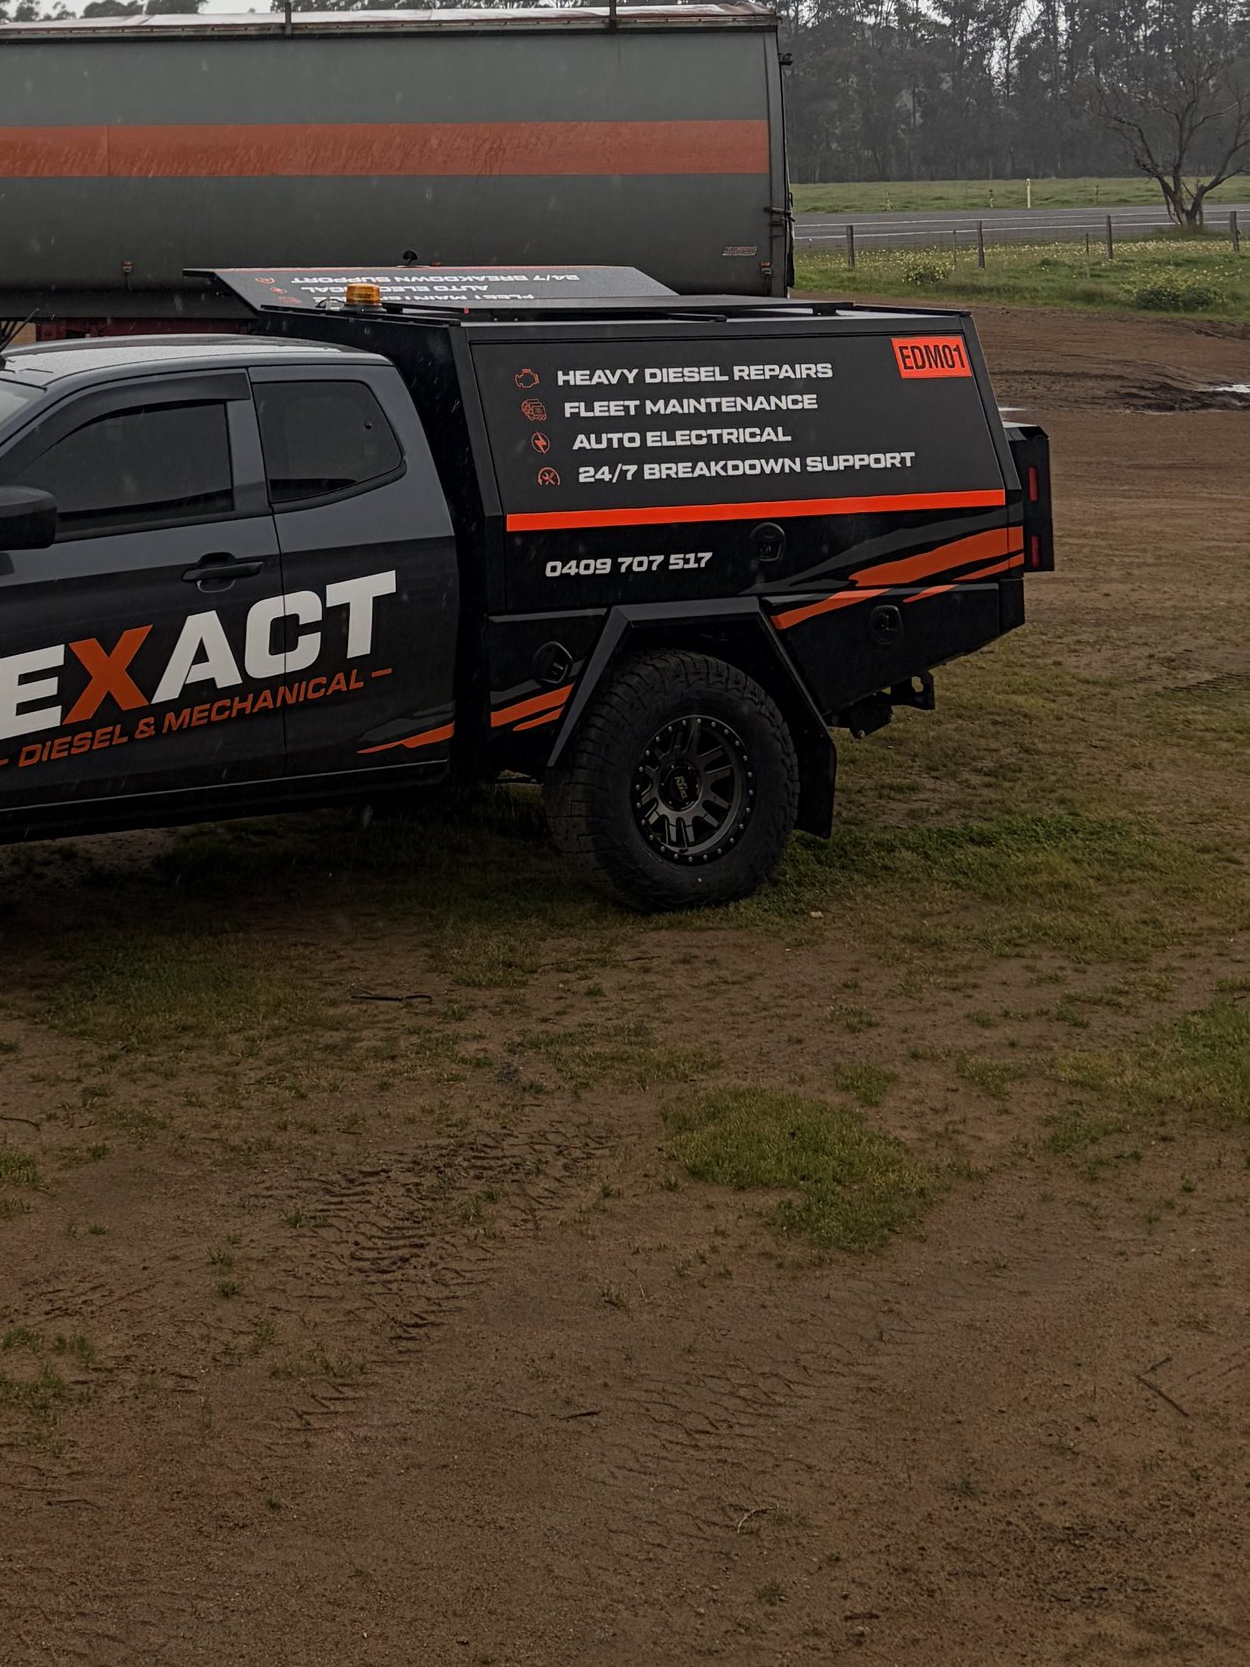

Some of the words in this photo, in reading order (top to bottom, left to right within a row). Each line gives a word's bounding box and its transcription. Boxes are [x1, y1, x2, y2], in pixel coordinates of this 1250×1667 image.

[291, 276, 391, 284] SUPPORT
[393, 275, 529, 283] BREAKDOWN
[898, 344, 965, 370] EDM01
[557, 368, 639, 386] HEAVY
[644, 366, 729, 384] DIESEL
[733, 363, 833, 381] REPAIRS
[564, 400, 640, 418] FLEET
[645, 394, 818, 416] MAINTENANCE
[572, 432, 641, 450] AUTO
[646, 427, 792, 447] ELECTRICAL
[578, 463, 638, 483] 24/7
[643, 457, 801, 480] BREAKDOWN
[806, 452, 915, 472] SUPPORT
[545, 558, 612, 577] 0409
[617, 555, 664, 573] 707
[668, 552, 713, 570] 517
[17, 724, 128, 768] DIESEL
[134, 716, 156, 739] &
[162, 669, 364, 734] MECHANICAL
